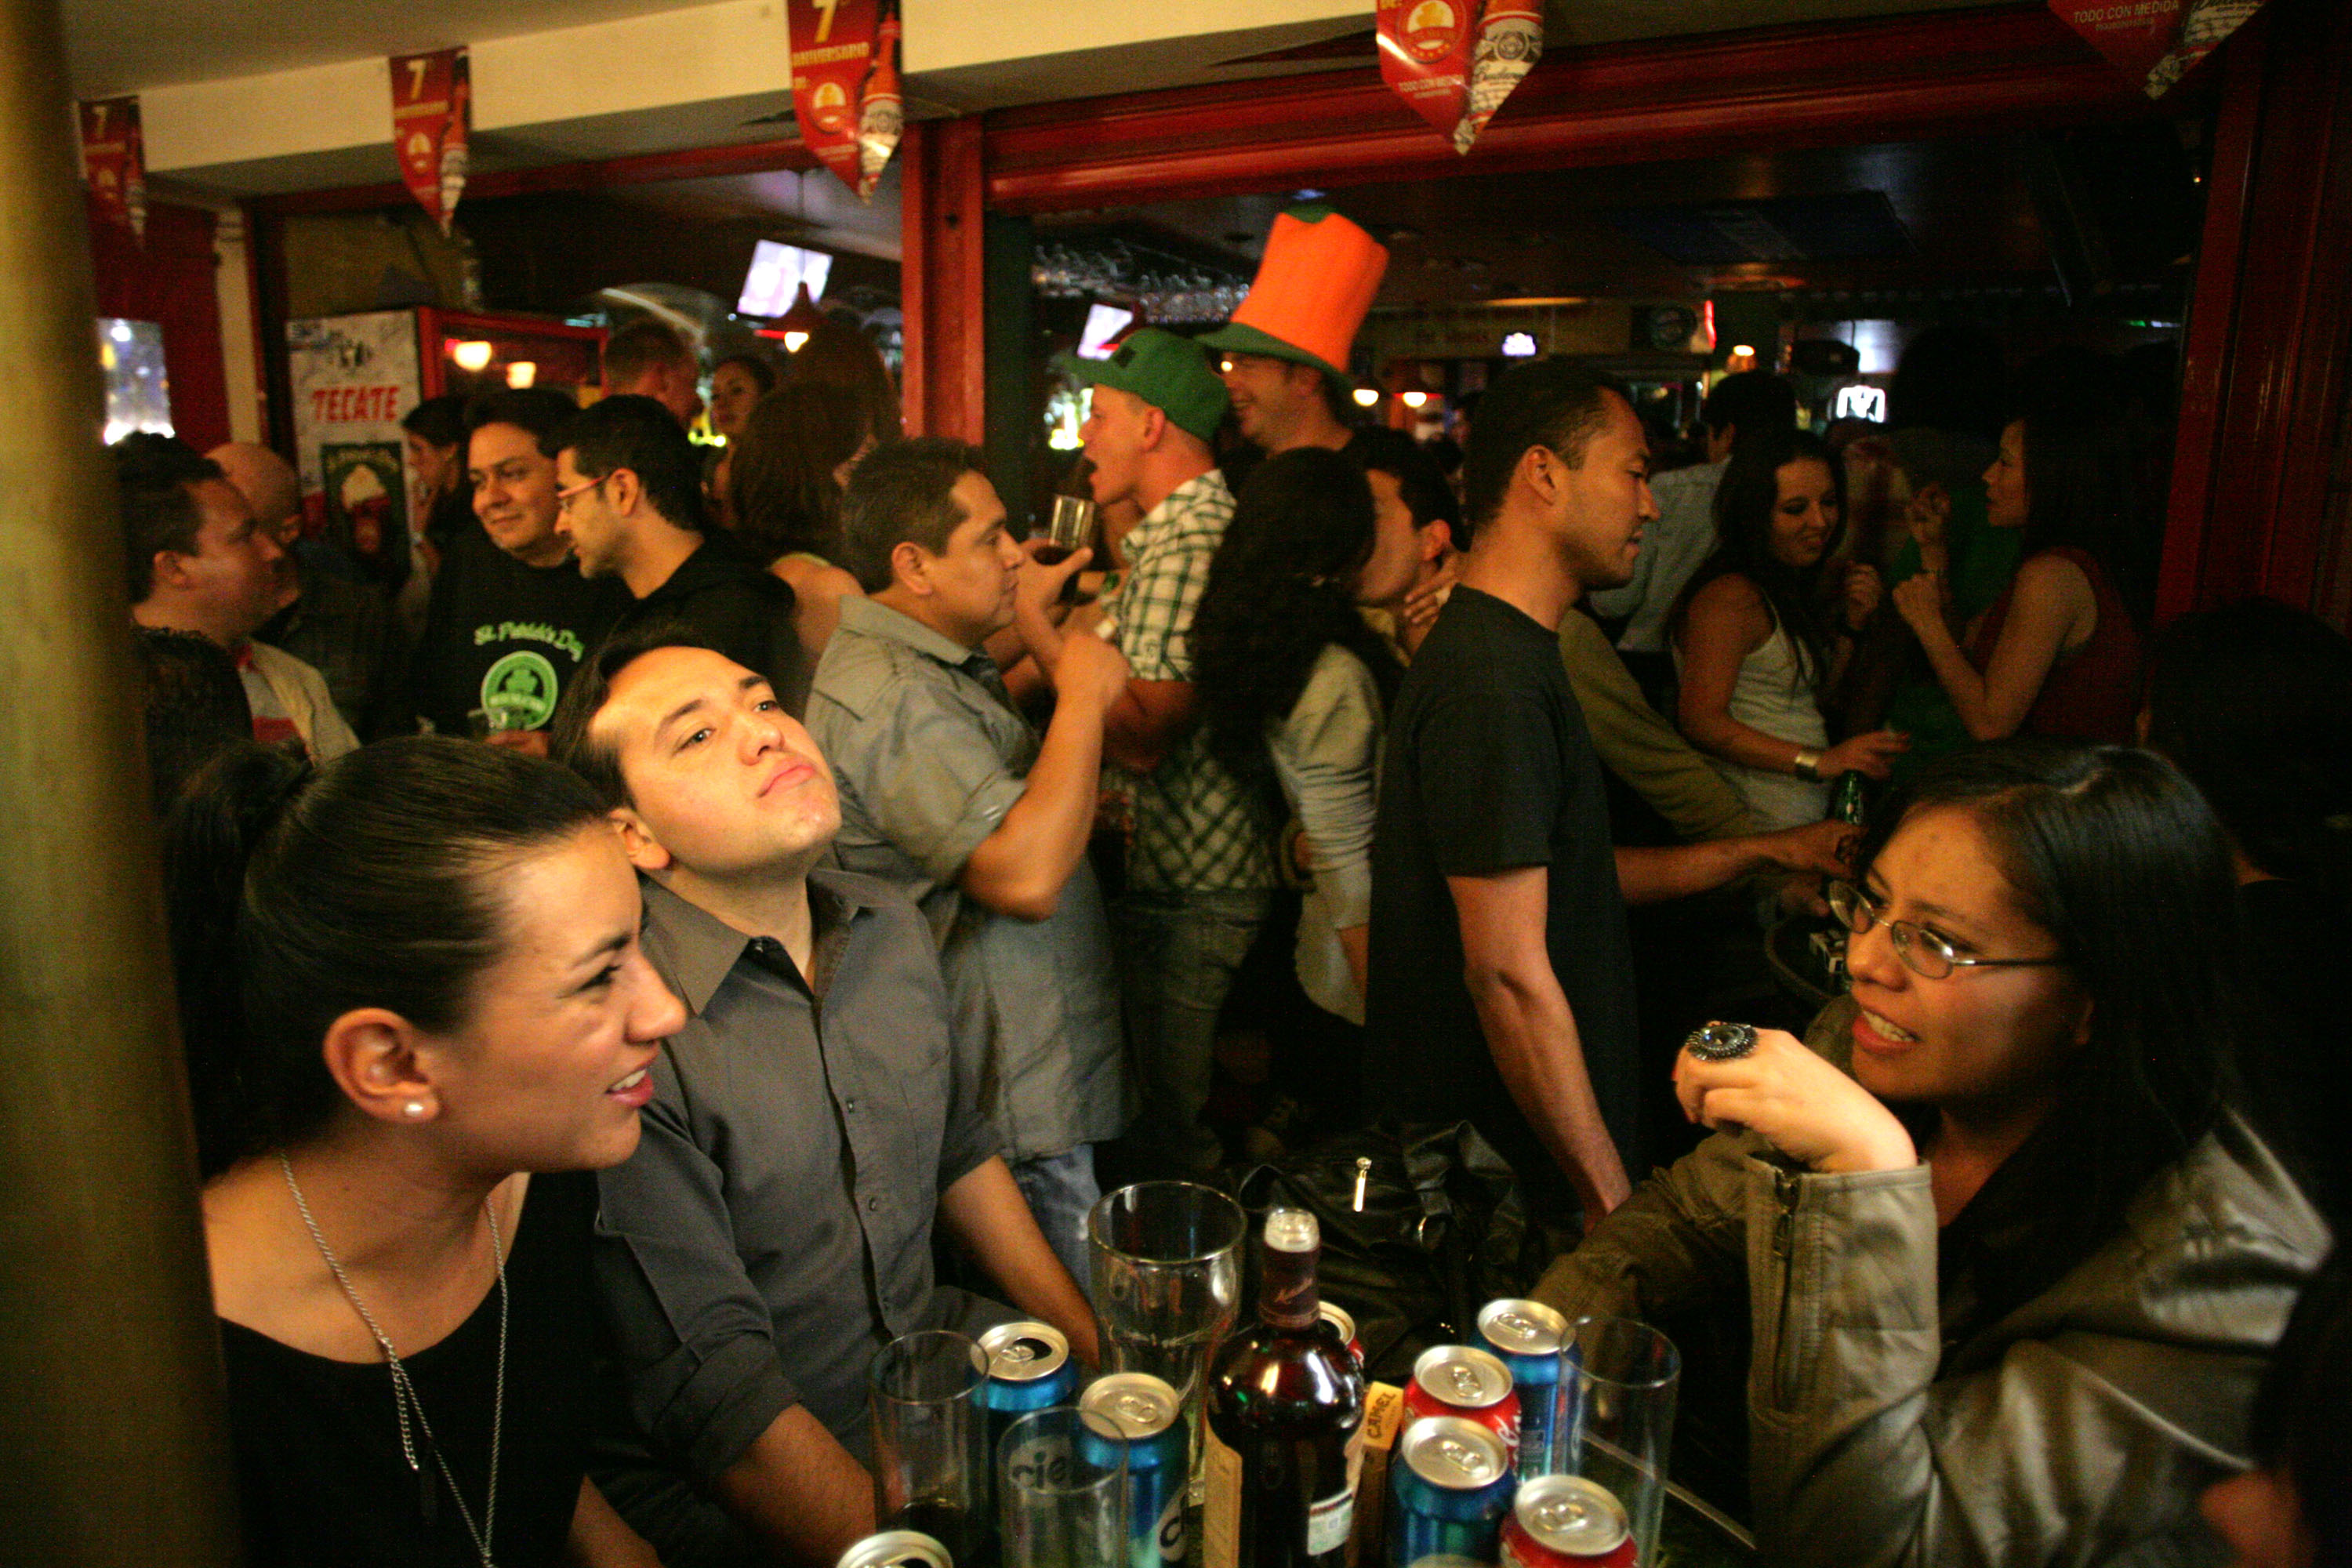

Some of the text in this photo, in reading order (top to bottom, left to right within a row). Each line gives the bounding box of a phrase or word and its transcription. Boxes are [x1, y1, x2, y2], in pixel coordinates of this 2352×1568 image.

[811, 0, 837, 43] 7
[2073, 1, 2180, 24] TODO CON MEDIDA
[407, 60, 426, 100] 7
[92, 105, 107, 138] 7
[312, 385, 401, 421] TECATE
[554, 630, 586, 663] Day
[1367, 1391, 1397, 1439] CAMEL
